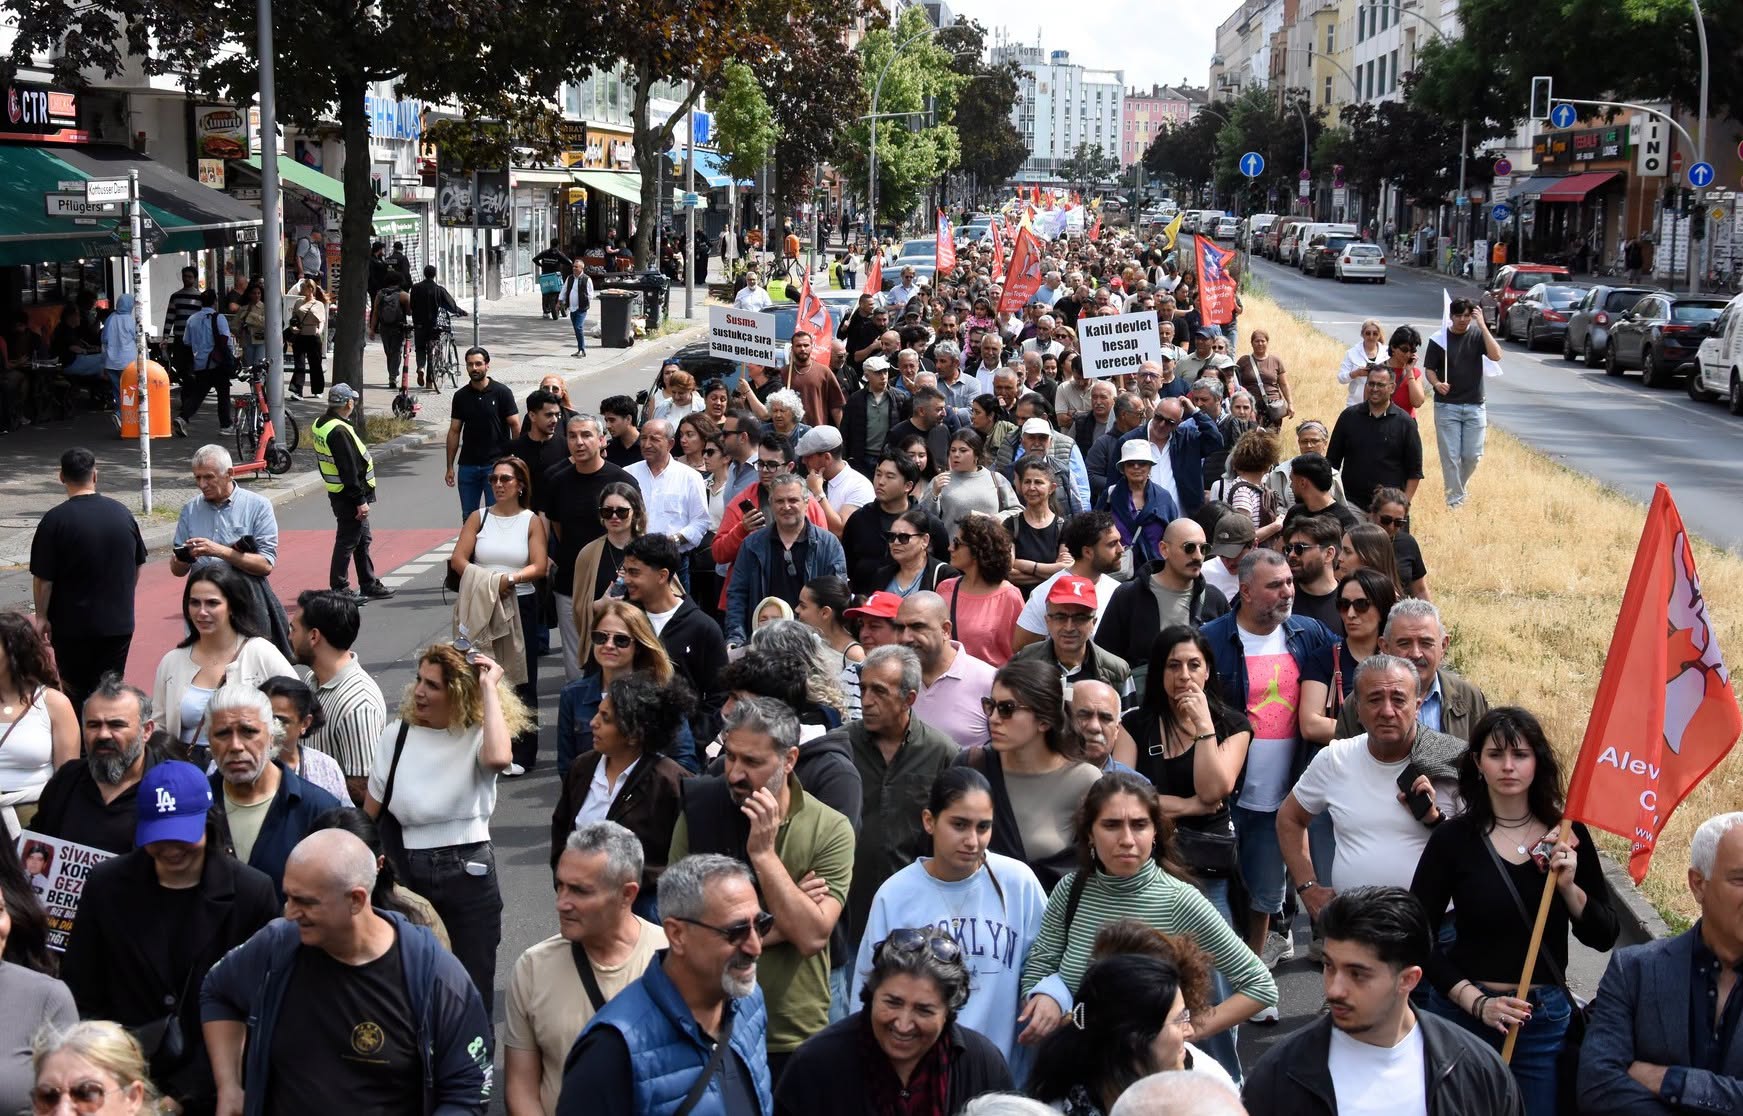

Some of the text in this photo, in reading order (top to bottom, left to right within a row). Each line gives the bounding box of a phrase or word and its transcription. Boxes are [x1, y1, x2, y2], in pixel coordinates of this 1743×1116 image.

[22, 90, 48, 124] CTR
[726, 314, 758, 329] Susma,
[1085, 319, 1152, 338] Katil devlet
[712, 327, 772, 346] sustukça sıra
[1102, 339, 1139, 352] hesap
[711, 341, 773, 361] sana gelecek!
[1095, 353, 1143, 370] verecek
[1597, 746, 1661, 780] Alev
[155, 787, 177, 813] LA
[922, 918, 1018, 969] KLYN
